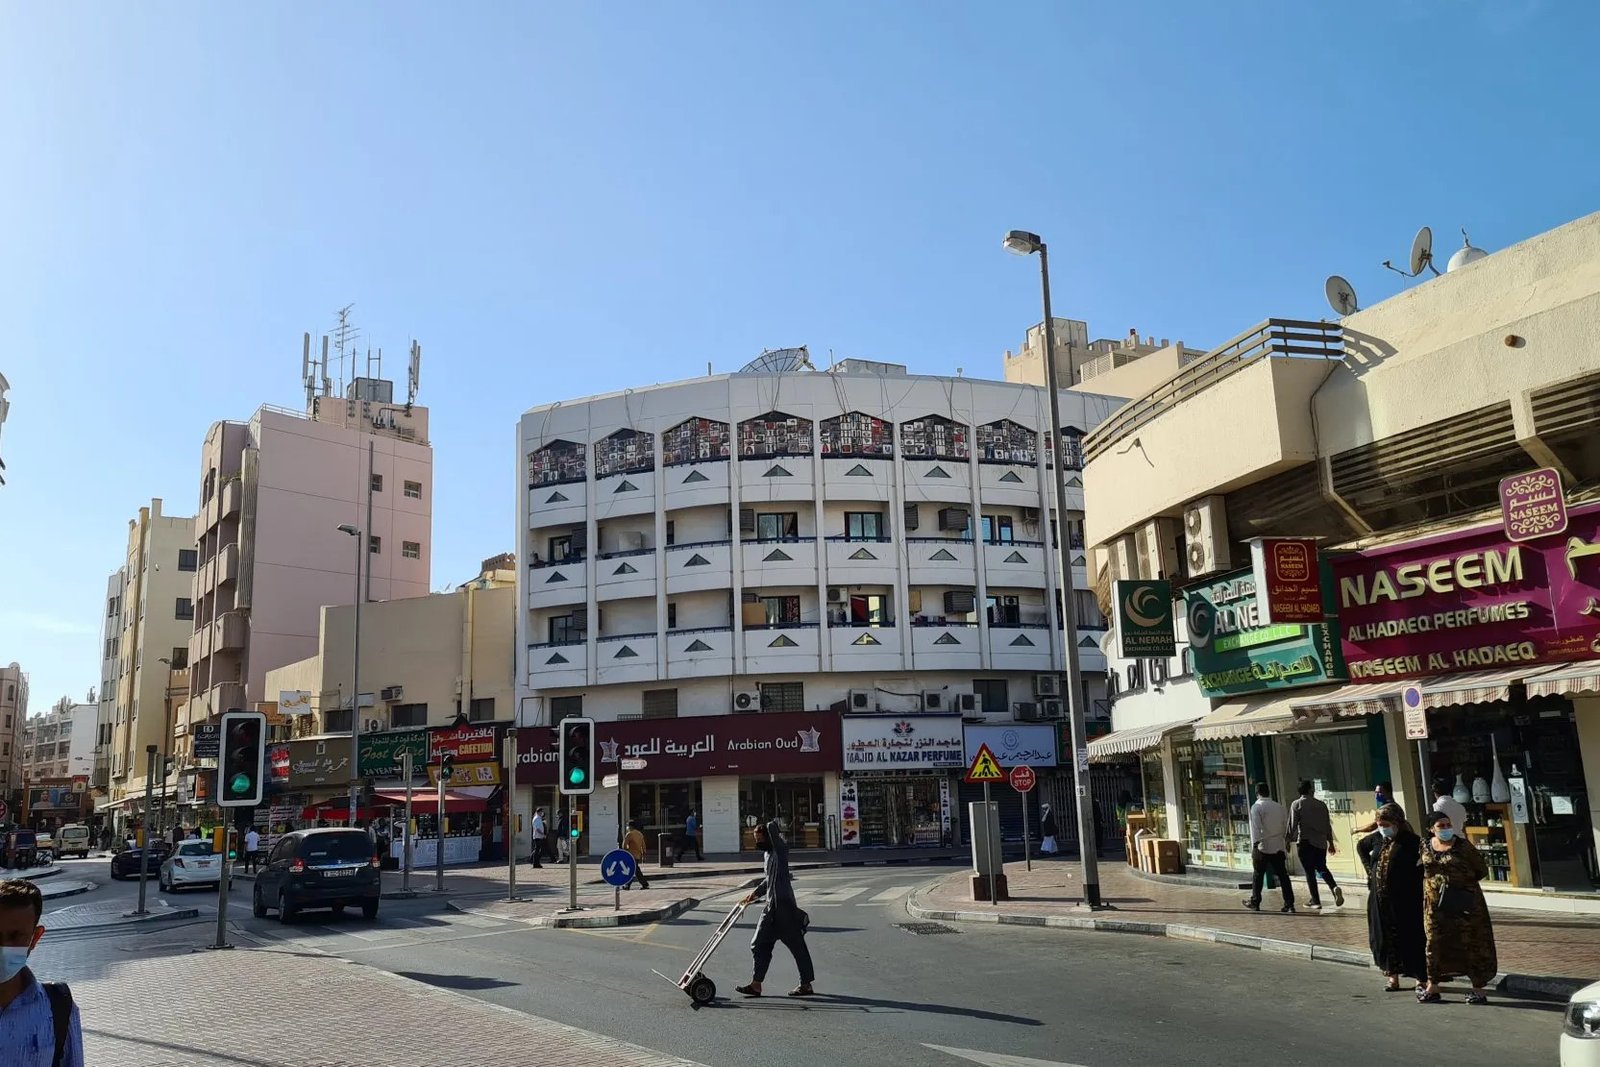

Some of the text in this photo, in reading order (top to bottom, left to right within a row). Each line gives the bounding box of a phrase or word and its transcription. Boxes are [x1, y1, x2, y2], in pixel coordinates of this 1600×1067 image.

[1510, 486, 1557, 511] نسيم
[1510, 503, 1558, 521] NASEEM
[1340, 545, 1524, 608] NASEEM
[1214, 609, 1236, 634] AL
[1348, 601, 1531, 641] AL HADAEQ PERFUMES
[1125, 635, 1173, 645] AL NEMAH
[1223, 632, 1259, 649] EXCHANGE
[1321, 623, 1335, 677] EXCHANGE
[1252, 656, 1313, 680] للصرافة
[1349, 641, 1537, 679] NASEEM AL HADAEQ
[1200, 667, 1251, 689] EXCHANGE
[458, 729, 493, 741] كافتيريا
[728, 737, 798, 750] Arabian Oud
[883, 738, 913, 750] لتجارة
[936, 738, 961, 748] ماجد
[517, 747, 559, 764] rabian
[625, 735, 715, 758] العربية للعود
[847, 752, 874, 763] MAJID
[876, 752, 888, 762] AL
[890, 751, 920, 762] NAZAR
[922, 750, 962, 761] PERFUME
[1014, 769, 1030, 778] قف
